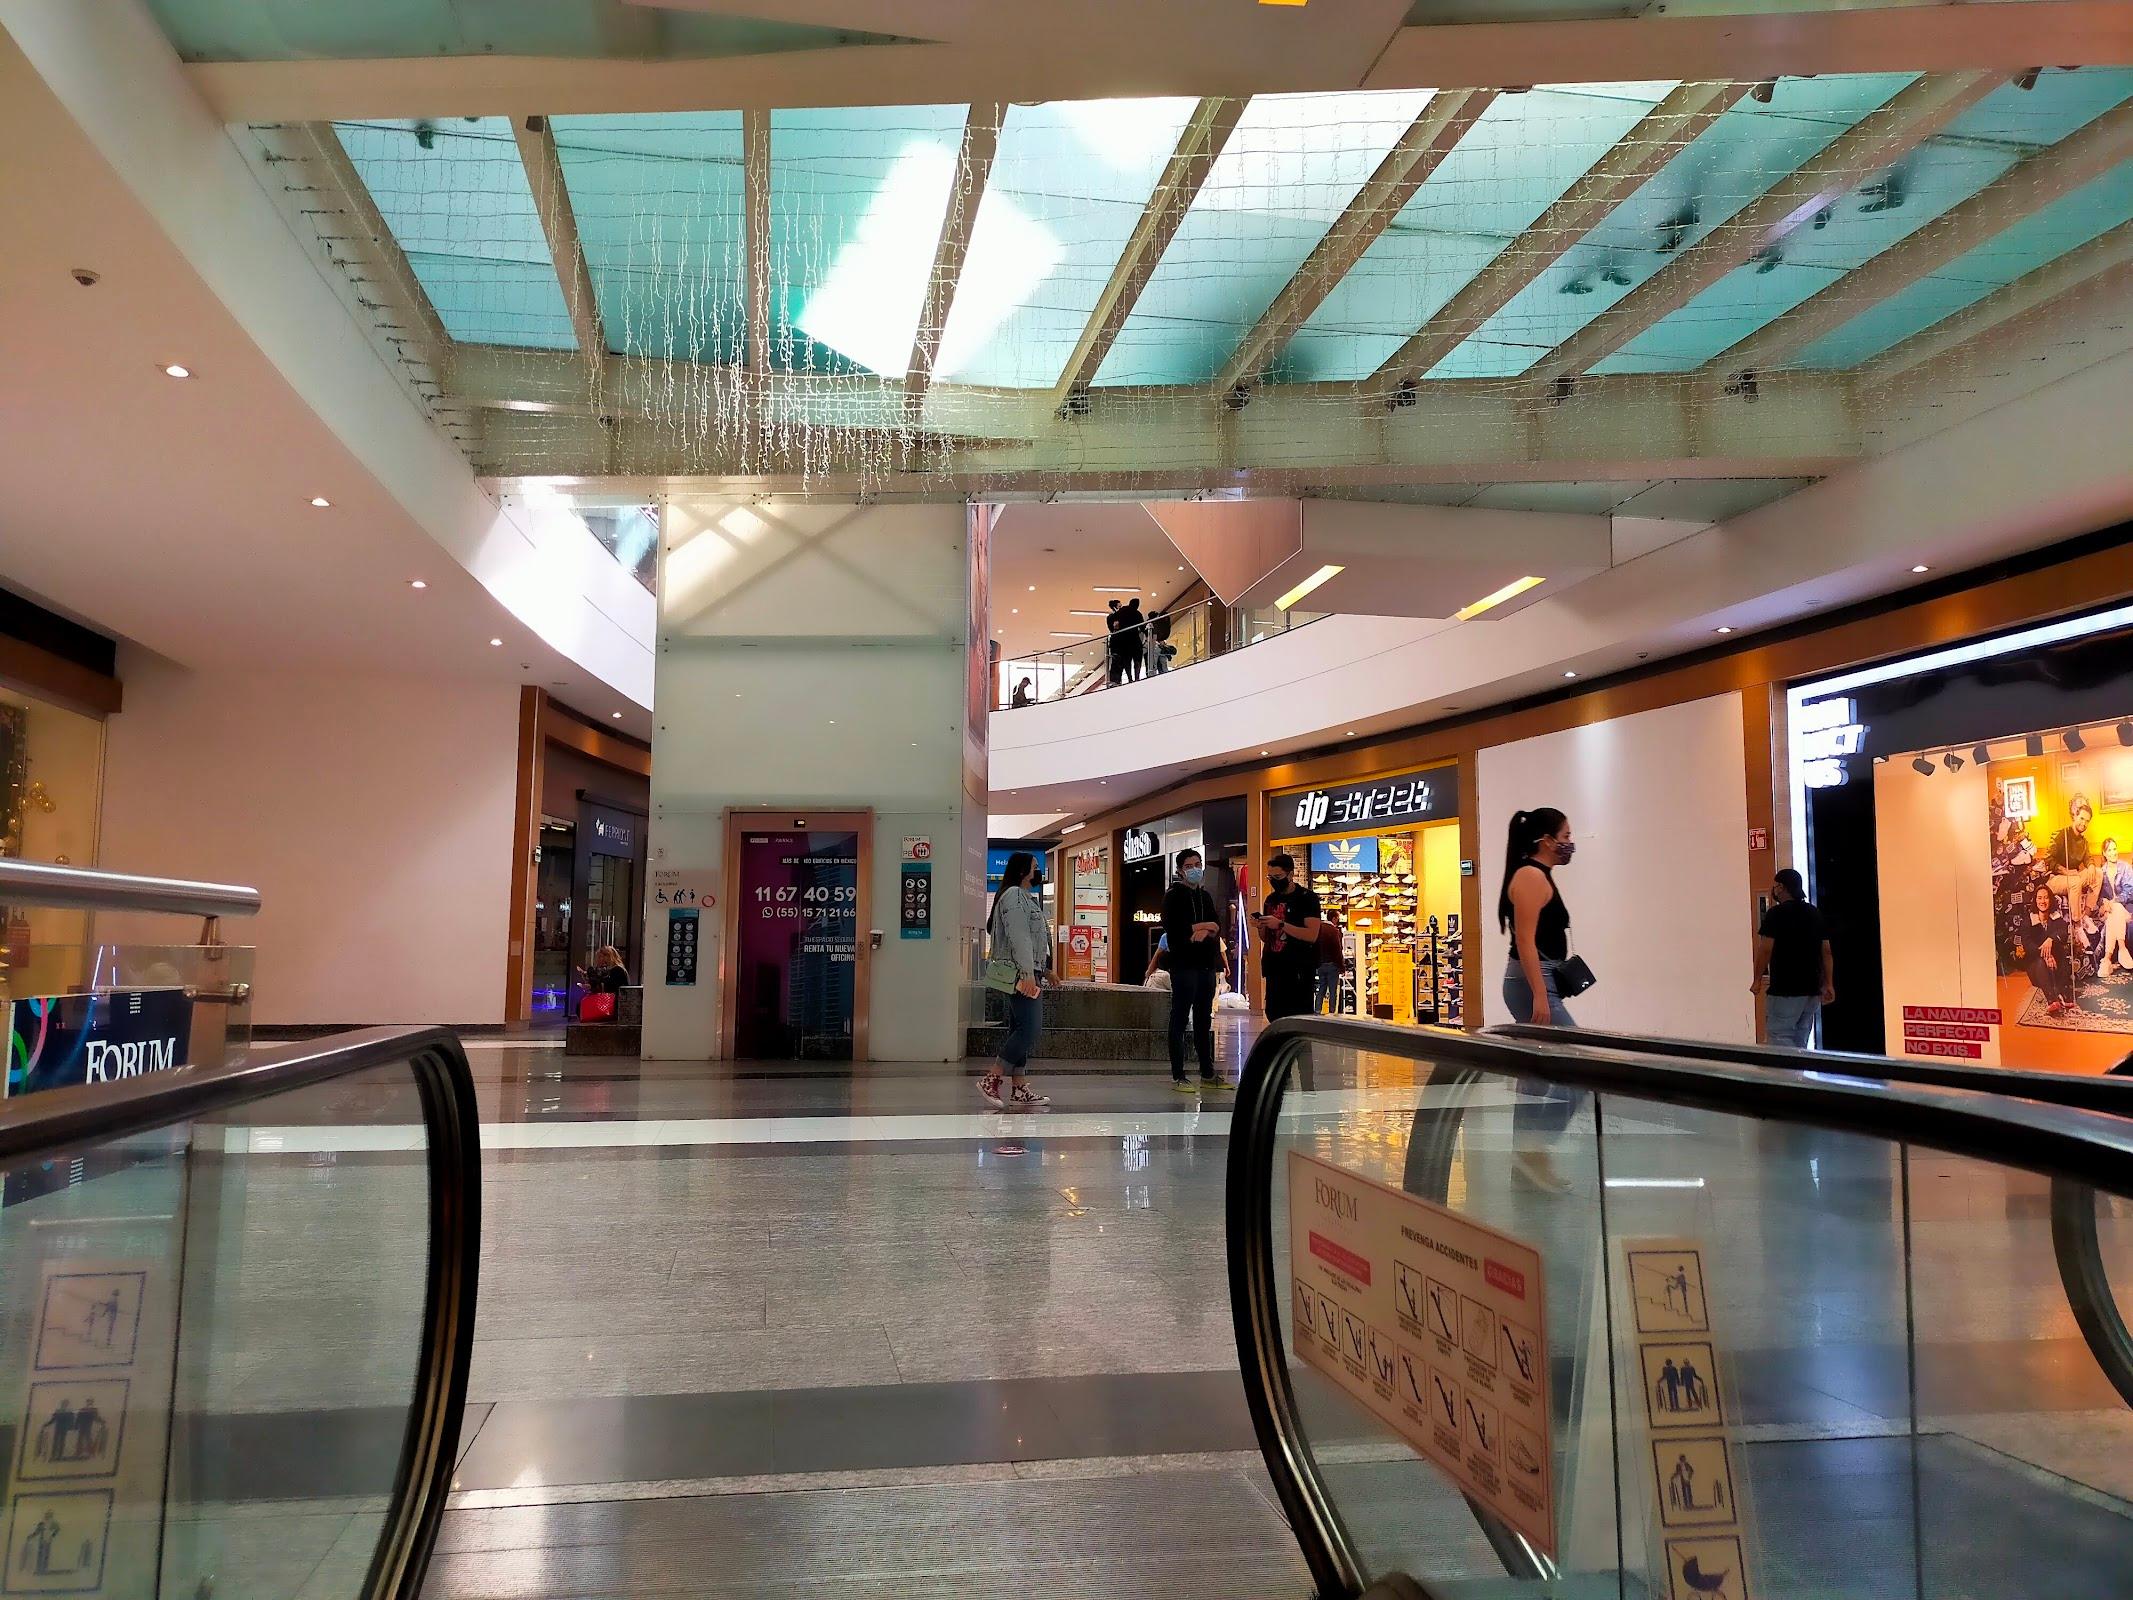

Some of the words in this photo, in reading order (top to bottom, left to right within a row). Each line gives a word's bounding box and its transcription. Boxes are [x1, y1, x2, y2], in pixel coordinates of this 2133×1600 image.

[1295, 790, 1330, 830] dp
[1123, 828, 1152, 860] shasa
[755, 886, 771, 902] 11
[775, 886, 798, 902] 67
[803, 886, 829, 902] 40
[833, 886, 857, 902] 59
[776, 906, 799, 918] (55)
[801, 908, 814, 917] 15
[815, 908, 827, 917] 71
[829, 908, 841, 917] 21
[842, 908, 856, 917] 66
[1133, 910, 1161, 922] shas
[804, 944, 825, 953] RENTA
[826, 944, 835, 953] TU
[835, 944, 856, 953] NUEVA
[1904, 1008, 1925, 1019] LA
[1927, 1008, 2000, 1023] NAVIDAD
[1905, 1024, 1987, 1039] PERFECTA
[1906, 1041, 1930, 1054] NO
[86, 1037, 176, 1085] FORUM
[1314, 1177, 1359, 1222] FORUM
